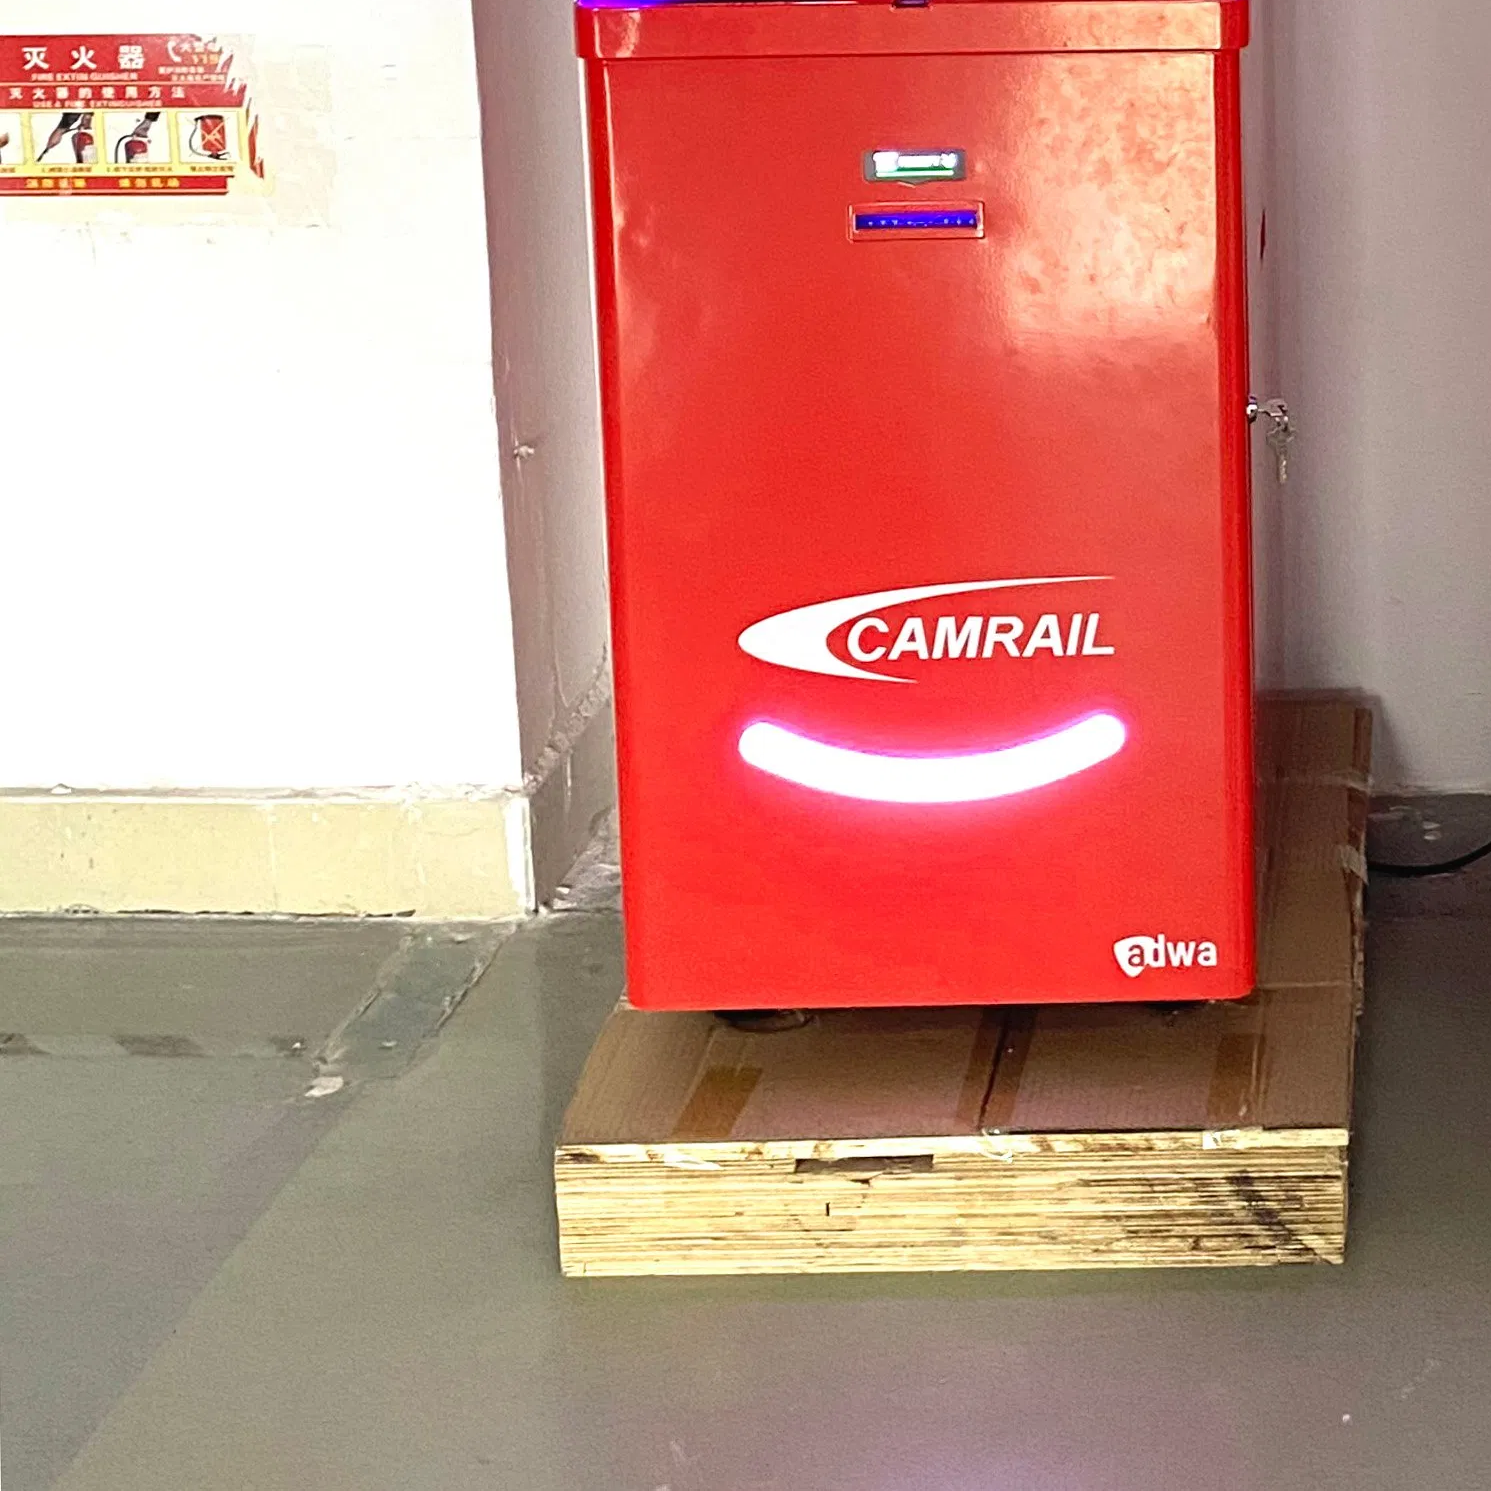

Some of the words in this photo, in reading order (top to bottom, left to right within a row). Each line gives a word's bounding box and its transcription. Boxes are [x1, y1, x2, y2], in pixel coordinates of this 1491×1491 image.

[22, 45, 145, 70] 灭火器
[846, 612, 1115, 662] CAMRAIL
